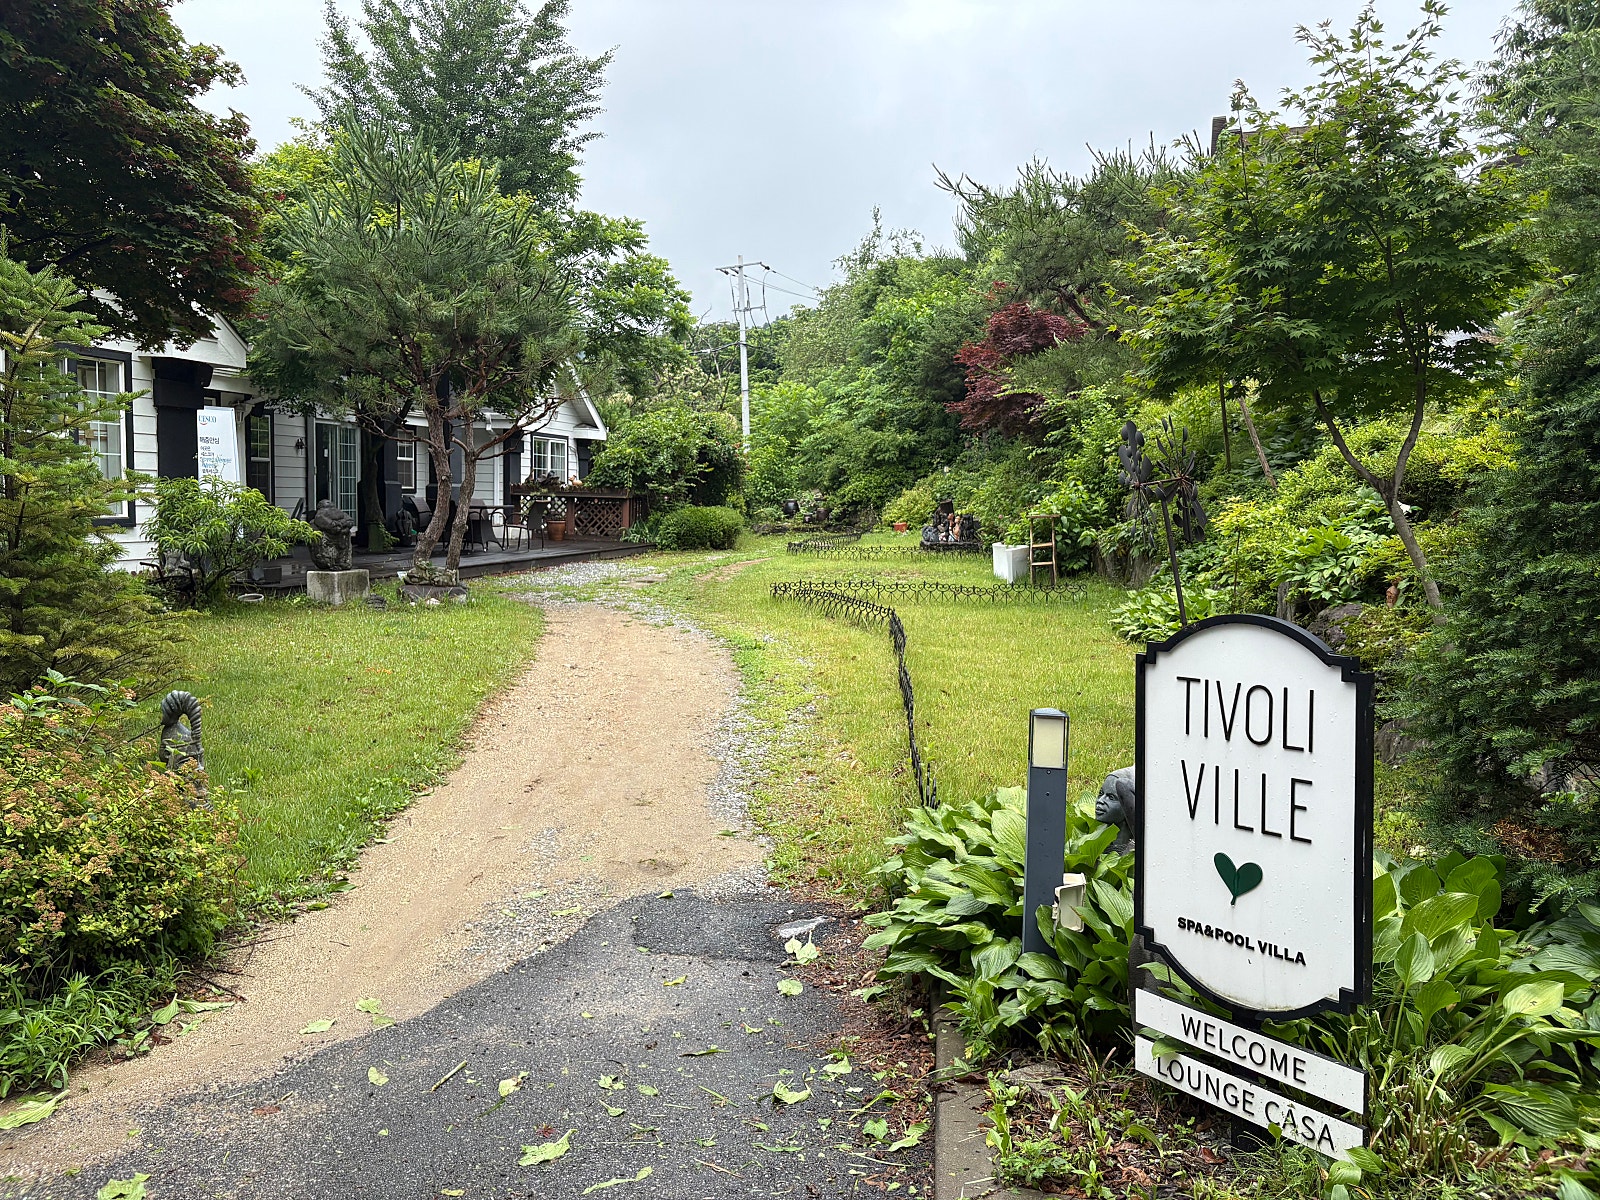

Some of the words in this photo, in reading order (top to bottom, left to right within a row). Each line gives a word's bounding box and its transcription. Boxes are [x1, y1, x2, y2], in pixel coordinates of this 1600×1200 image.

[1177, 676, 1314, 753] TIVOLI
[1181, 759, 1313, 845] VILLE
[1177, 916, 1255, 951] SPA&POOL
[1257, 940, 1307, 966] VILLA
[1181, 1013, 1307, 1085] WELCOME
[1157, 1056, 1255, 1117] LOUNGE
[1264, 1100, 1336, 1152] CASA
